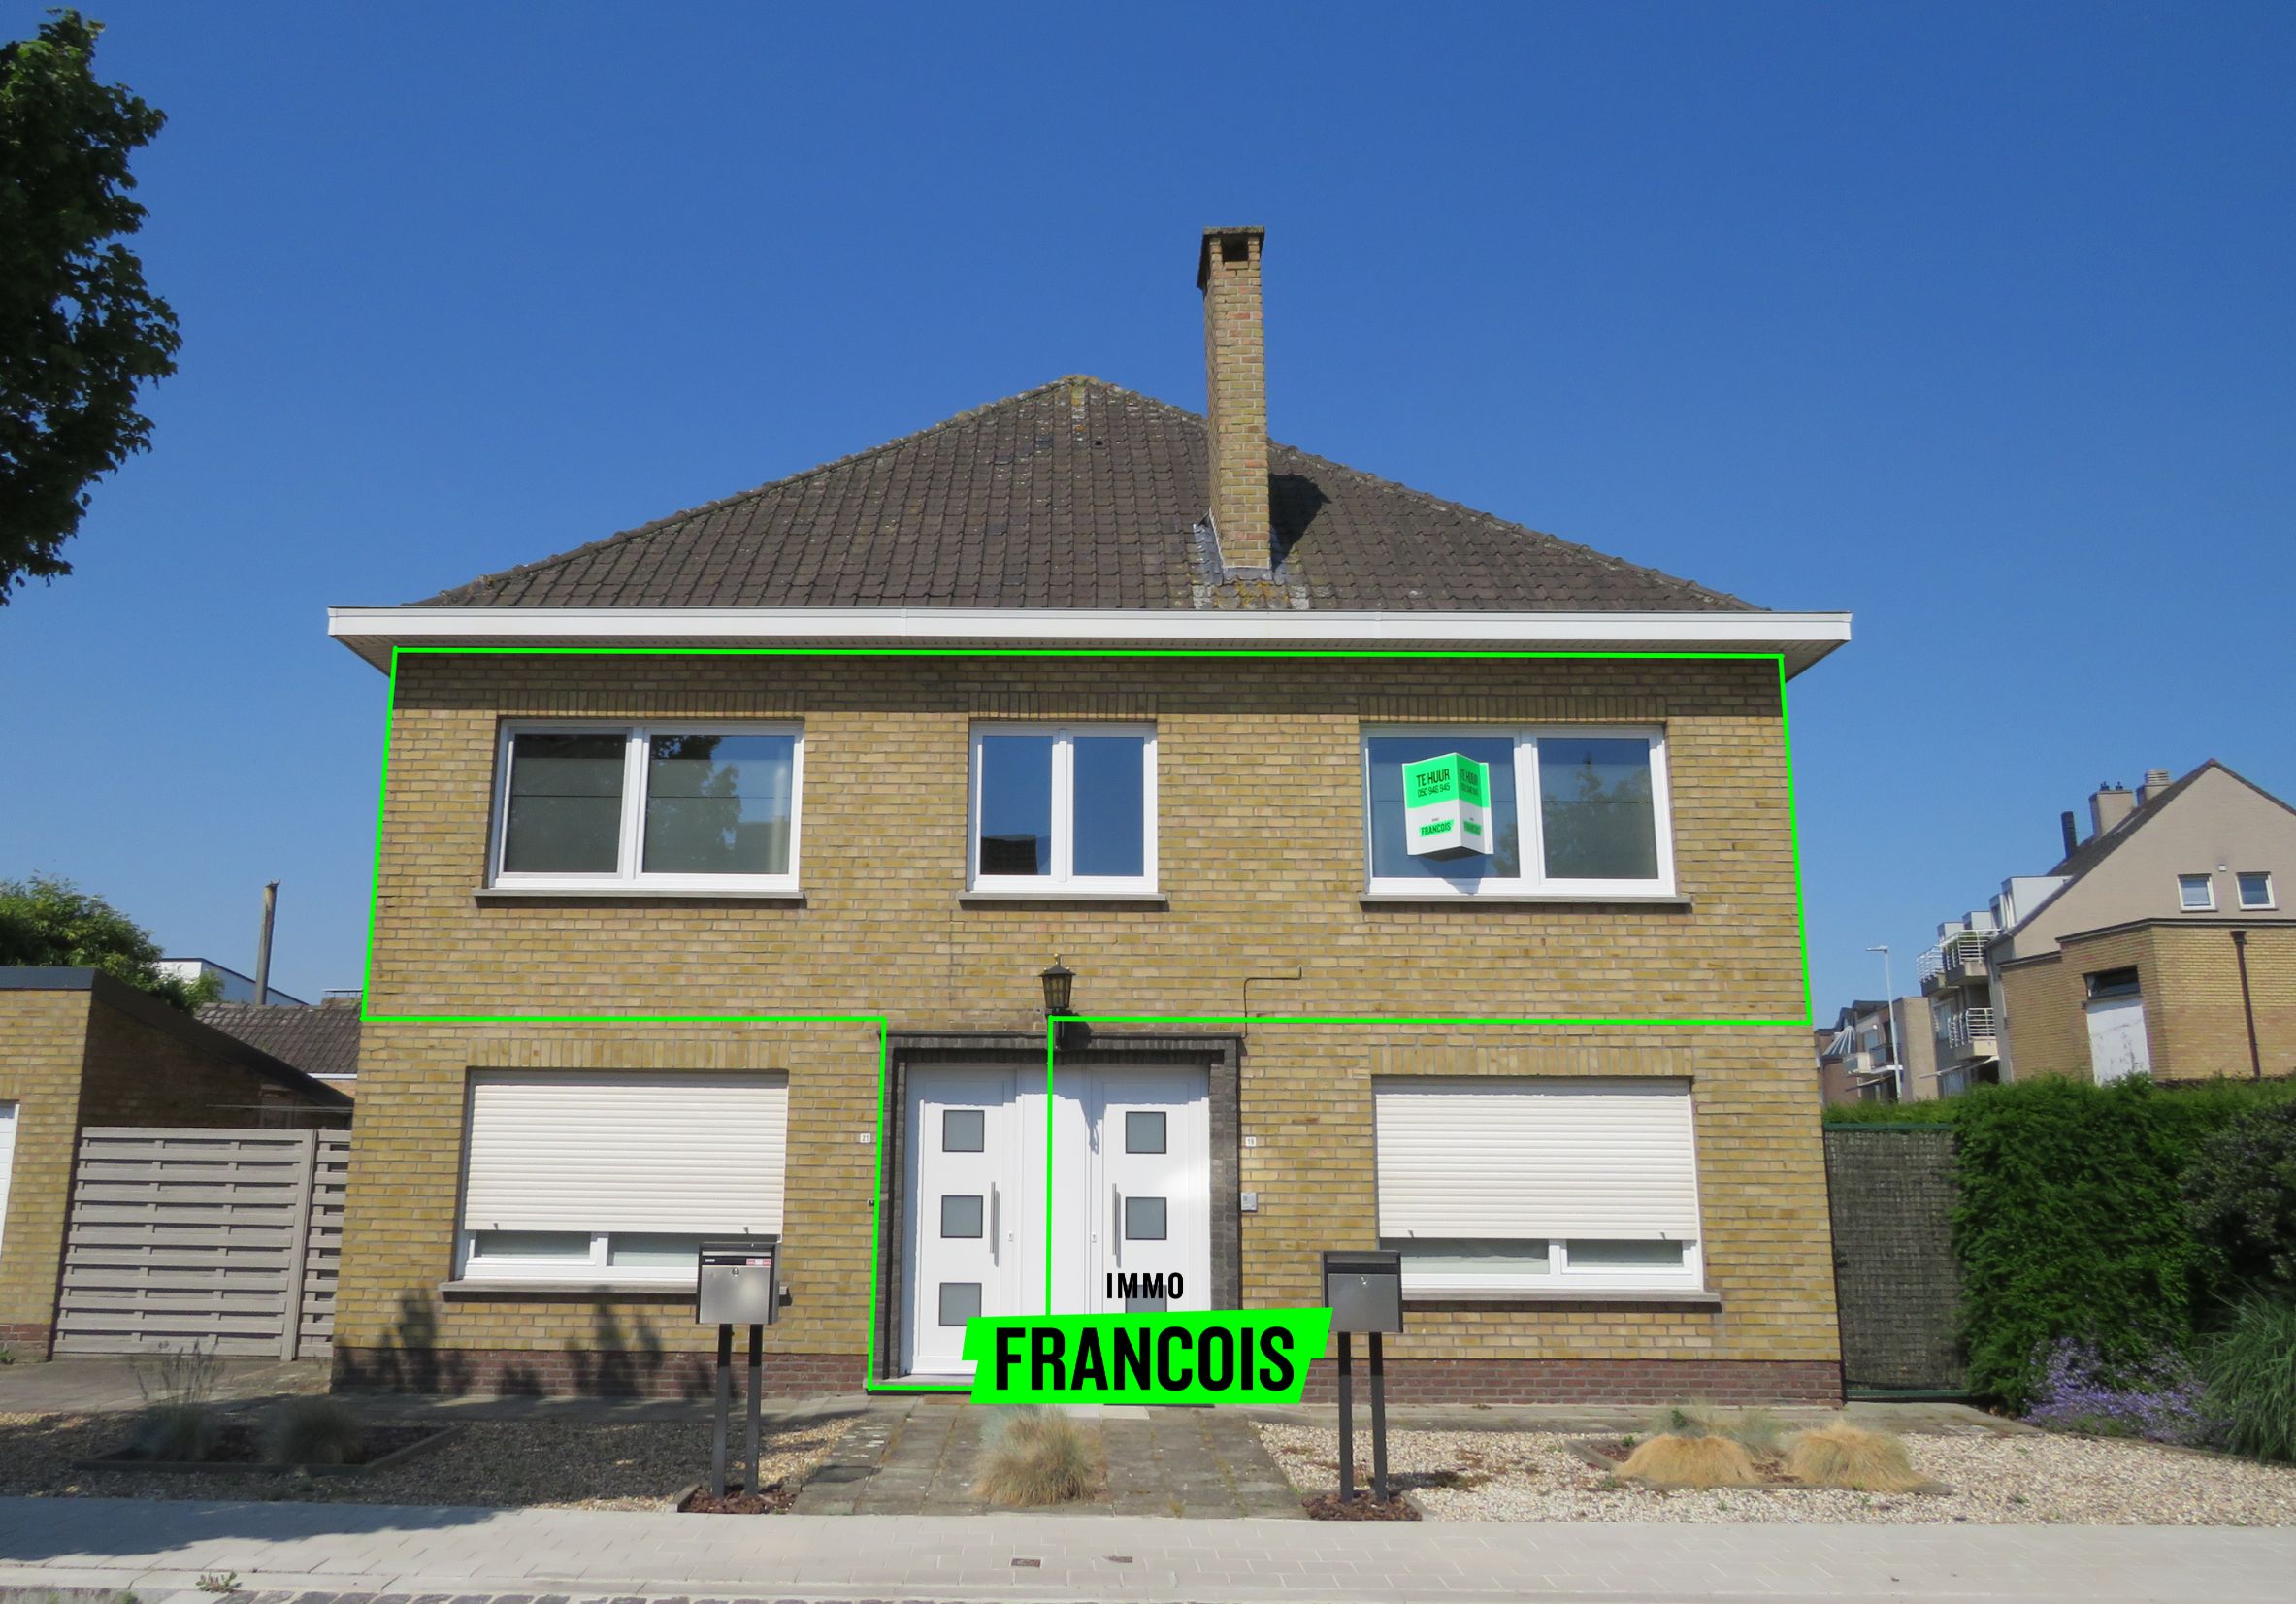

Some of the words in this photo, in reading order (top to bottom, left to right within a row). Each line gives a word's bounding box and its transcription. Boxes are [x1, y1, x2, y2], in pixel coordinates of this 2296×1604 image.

[1416, 773, 1427, 787] TE
[1427, 769, 1450, 784] HUUR
[1418, 788, 1427, 798] 050
[1421, 822, 1451, 835] FRANCOIS
